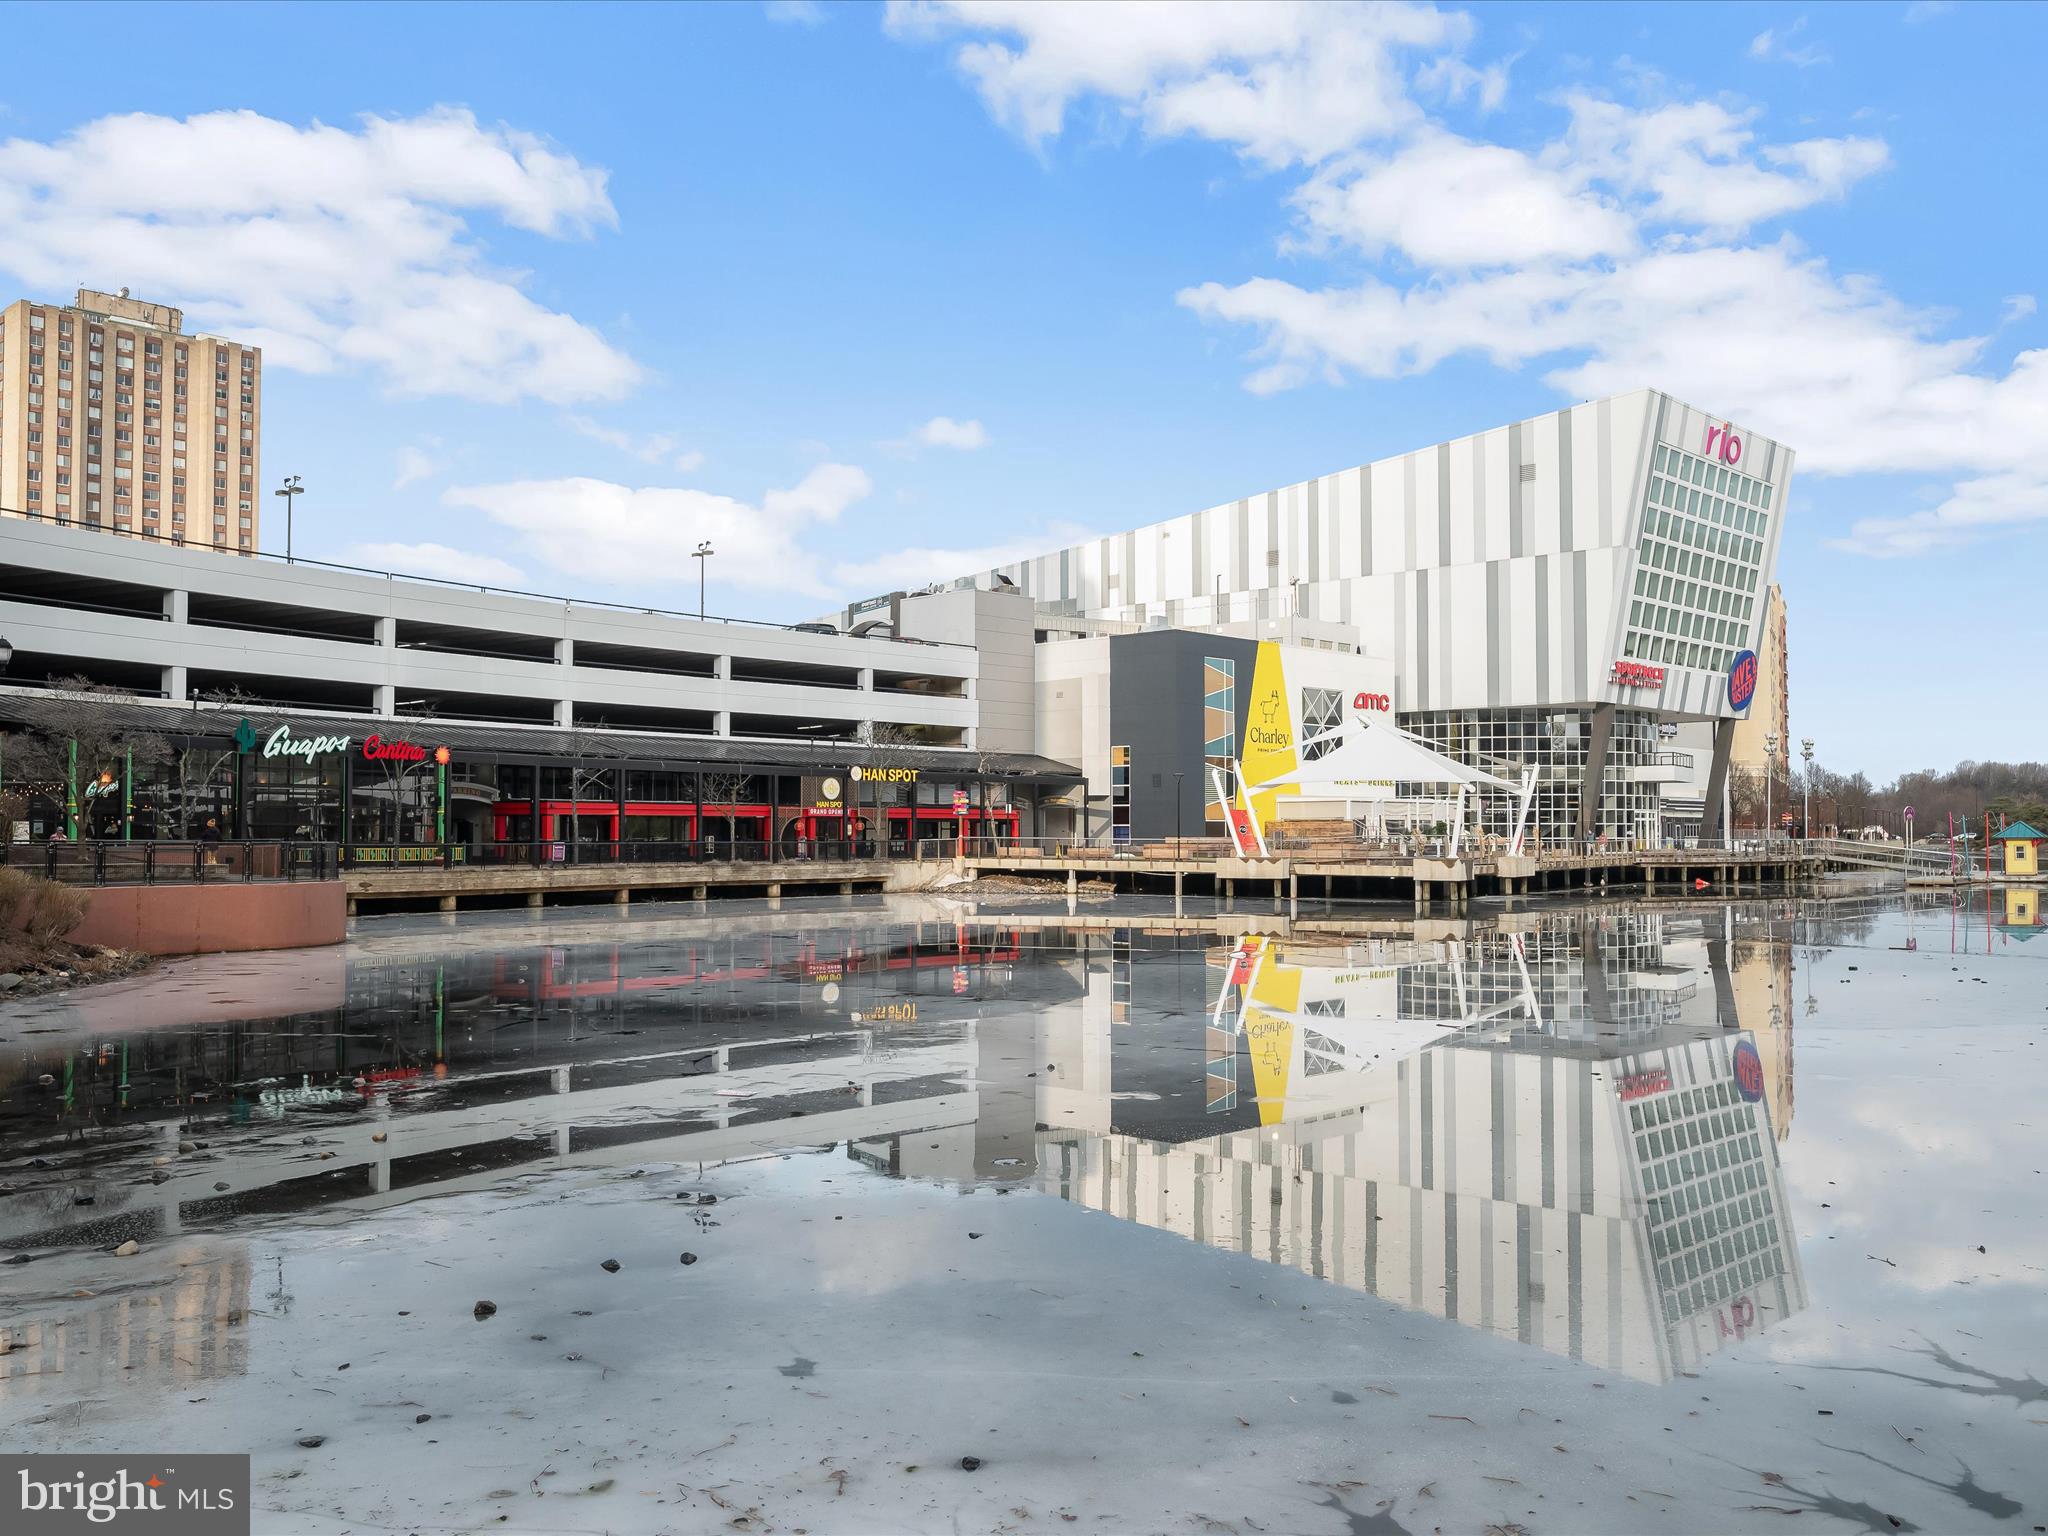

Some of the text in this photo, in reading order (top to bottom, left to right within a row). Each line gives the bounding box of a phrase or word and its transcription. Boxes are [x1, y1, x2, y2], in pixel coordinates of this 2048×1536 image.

[1705, 422, 1742, 465] rio
[263, 724, 427, 765] Guapos Cantina
[1250, 727, 1289, 748] Charley
[862, 767, 920, 783] HAN SPOT
